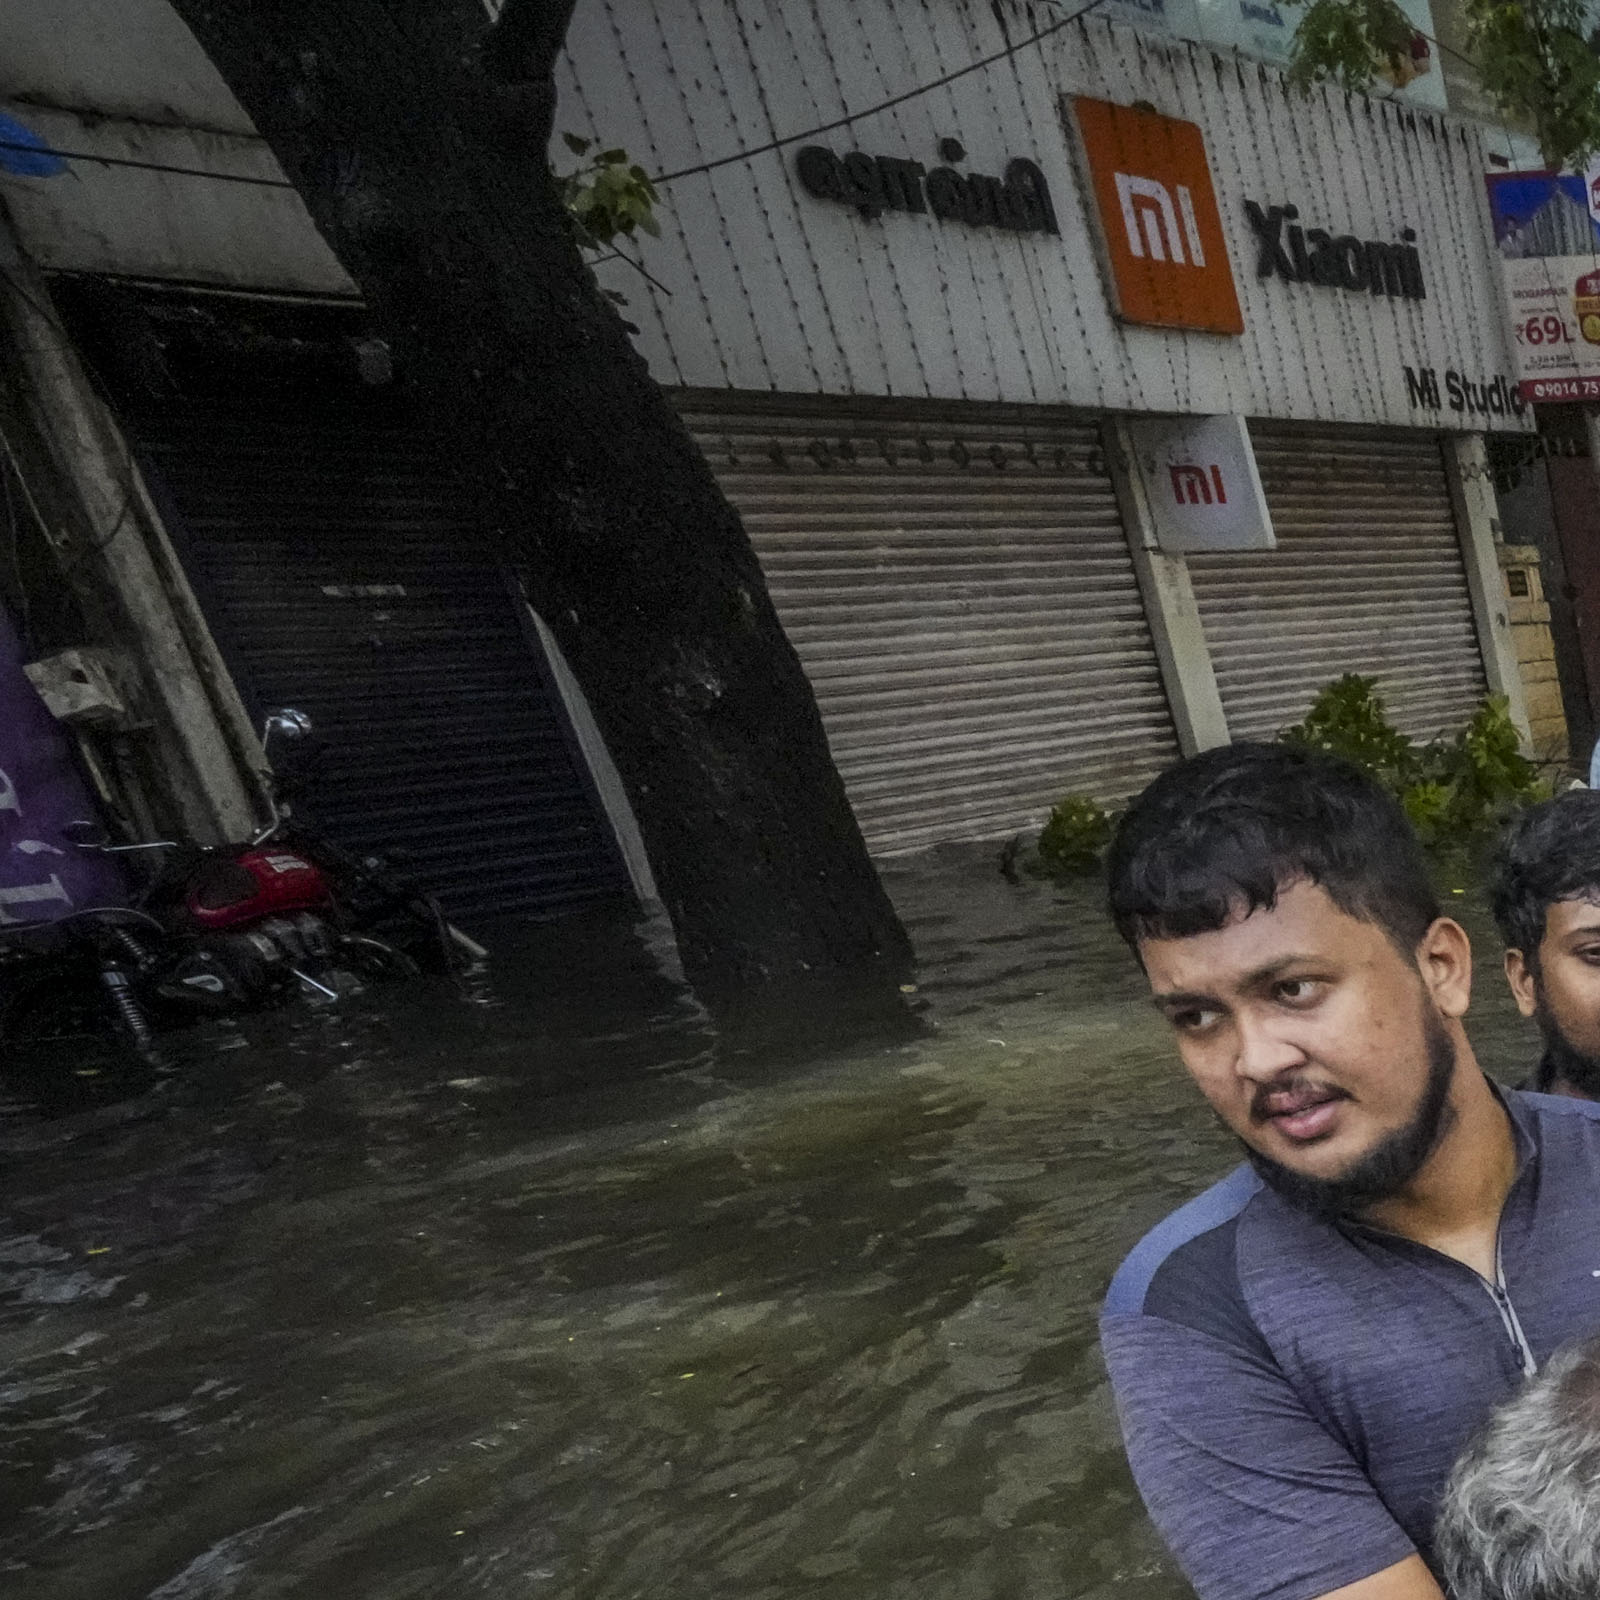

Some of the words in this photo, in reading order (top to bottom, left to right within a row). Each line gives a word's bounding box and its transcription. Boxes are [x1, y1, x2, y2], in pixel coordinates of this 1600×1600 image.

[1243, 199, 1427, 299] Xiaomi
[1403, 365, 1442, 410] Mi
[1544, 381, 1578, 396] 9014
